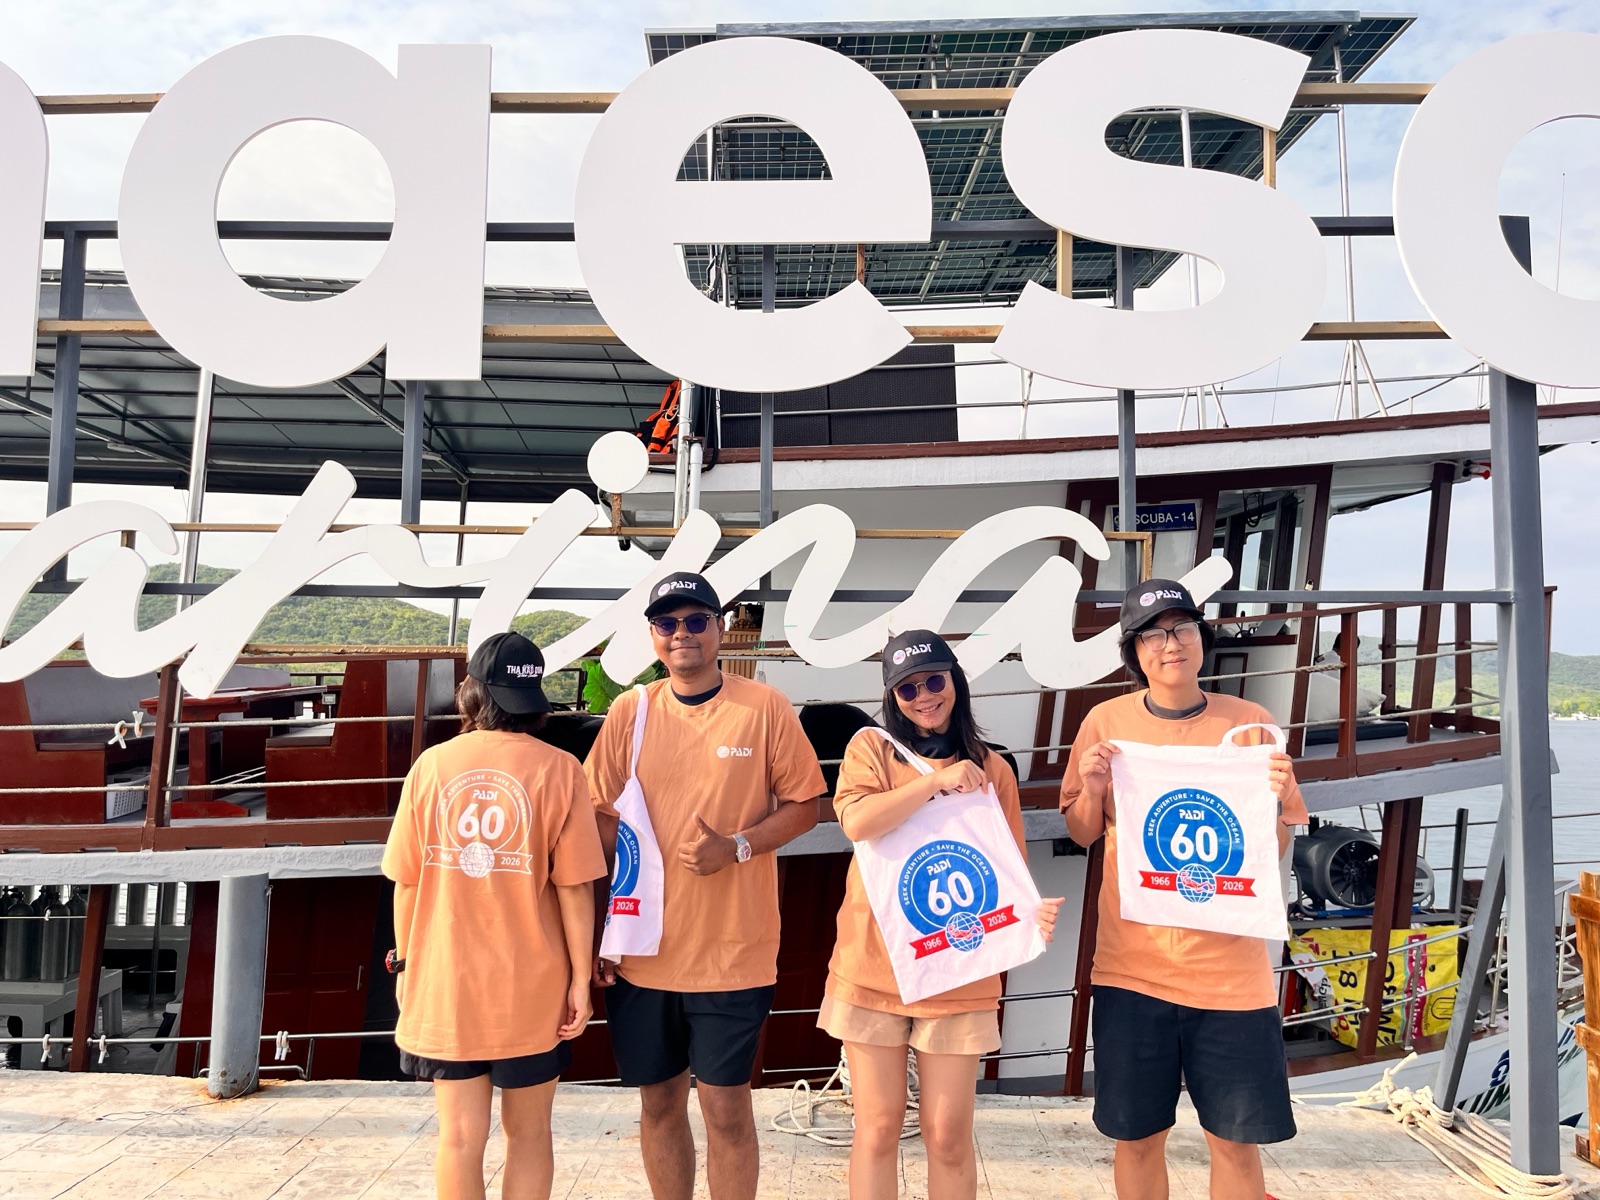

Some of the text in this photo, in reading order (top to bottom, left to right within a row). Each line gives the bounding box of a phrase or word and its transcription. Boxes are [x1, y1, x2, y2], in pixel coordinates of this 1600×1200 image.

[670, 580, 697, 590] PADI
[1155, 589, 1183, 600] PADI
[904, 643, 932, 657] PADI
[730, 747, 753, 757] PADI
[447, 774, 486, 796] ADVENTURE
[493, 775, 510, 787] SAVE
[510, 784, 521, 798] THE
[472, 789, 499, 801] PADI
[457, 802, 505, 840] 60
[1147, 792, 1240, 844] SEEK ADVENTURE SAVE THE OCEAN
[1178, 808, 1205, 821] PADI
[957, 845, 971, 856] THE
[1170, 823, 1218, 862] 60
[501, 856, 521, 866] 2026
[629, 840, 638, 865] OCEAN
[904, 848, 930, 885] ADVENTURE
[926, 858, 952, 876] PADI
[971, 853, 990, 876] OCEAN
[1150, 876, 1244, 891] 1966 2026
[902, 887, 910, 906] SEEK
[928, 870, 975, 917] 60
[615, 901, 635, 911] 2026
[922, 912, 1008, 950] 1966 2026
